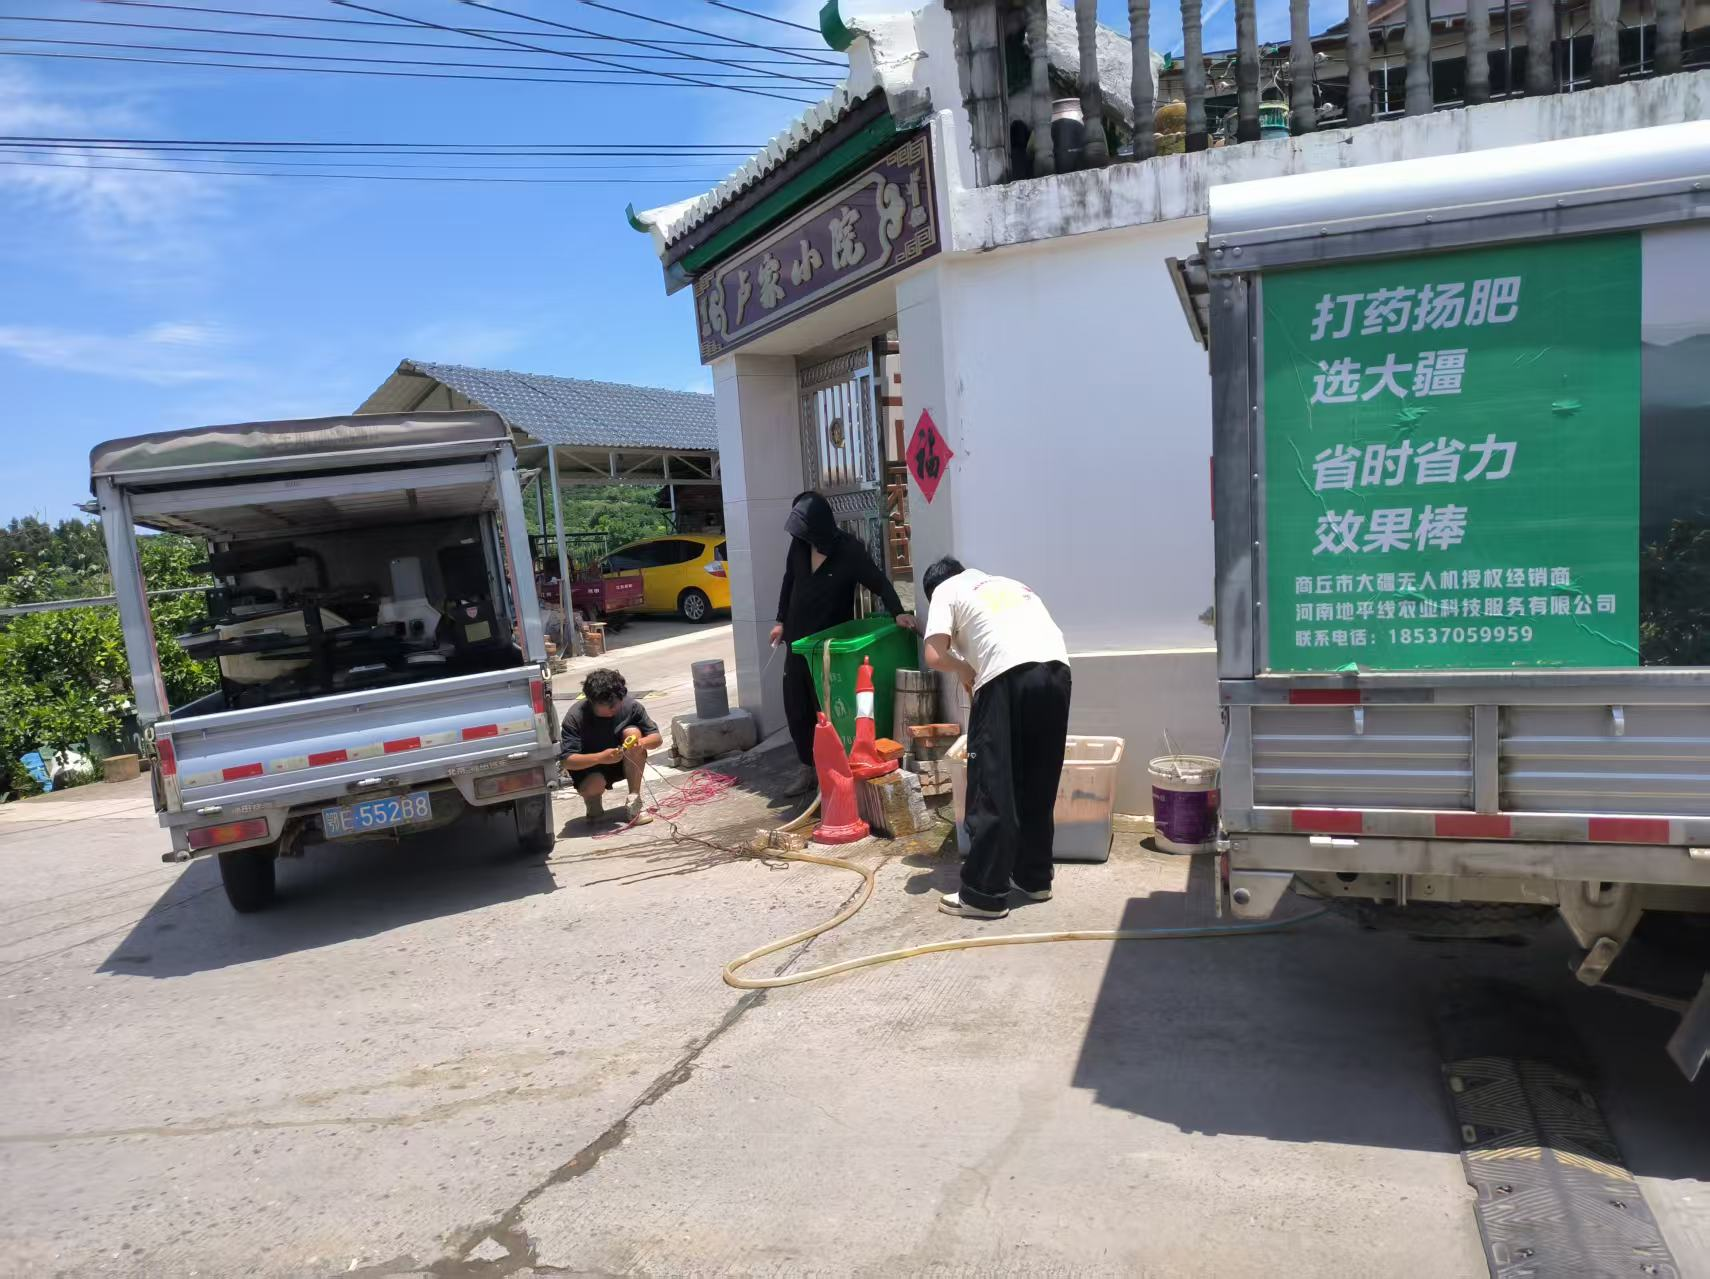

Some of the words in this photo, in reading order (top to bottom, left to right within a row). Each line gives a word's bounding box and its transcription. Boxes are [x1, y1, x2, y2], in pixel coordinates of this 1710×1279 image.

[1310, 276, 1521, 341] 打药扬肥
[1311, 348, 1468, 405] 选大疆
[916, 427, 940, 480] 福
[1312, 433, 1517, 491] 省时省力
[1312, 504, 1468, 555] 效果棒
[1295, 566, 1571, 594] 商丘市大疆无人机授权经销商
[1295, 595, 1616, 621] 河南地平线农业科技服务有限公司
